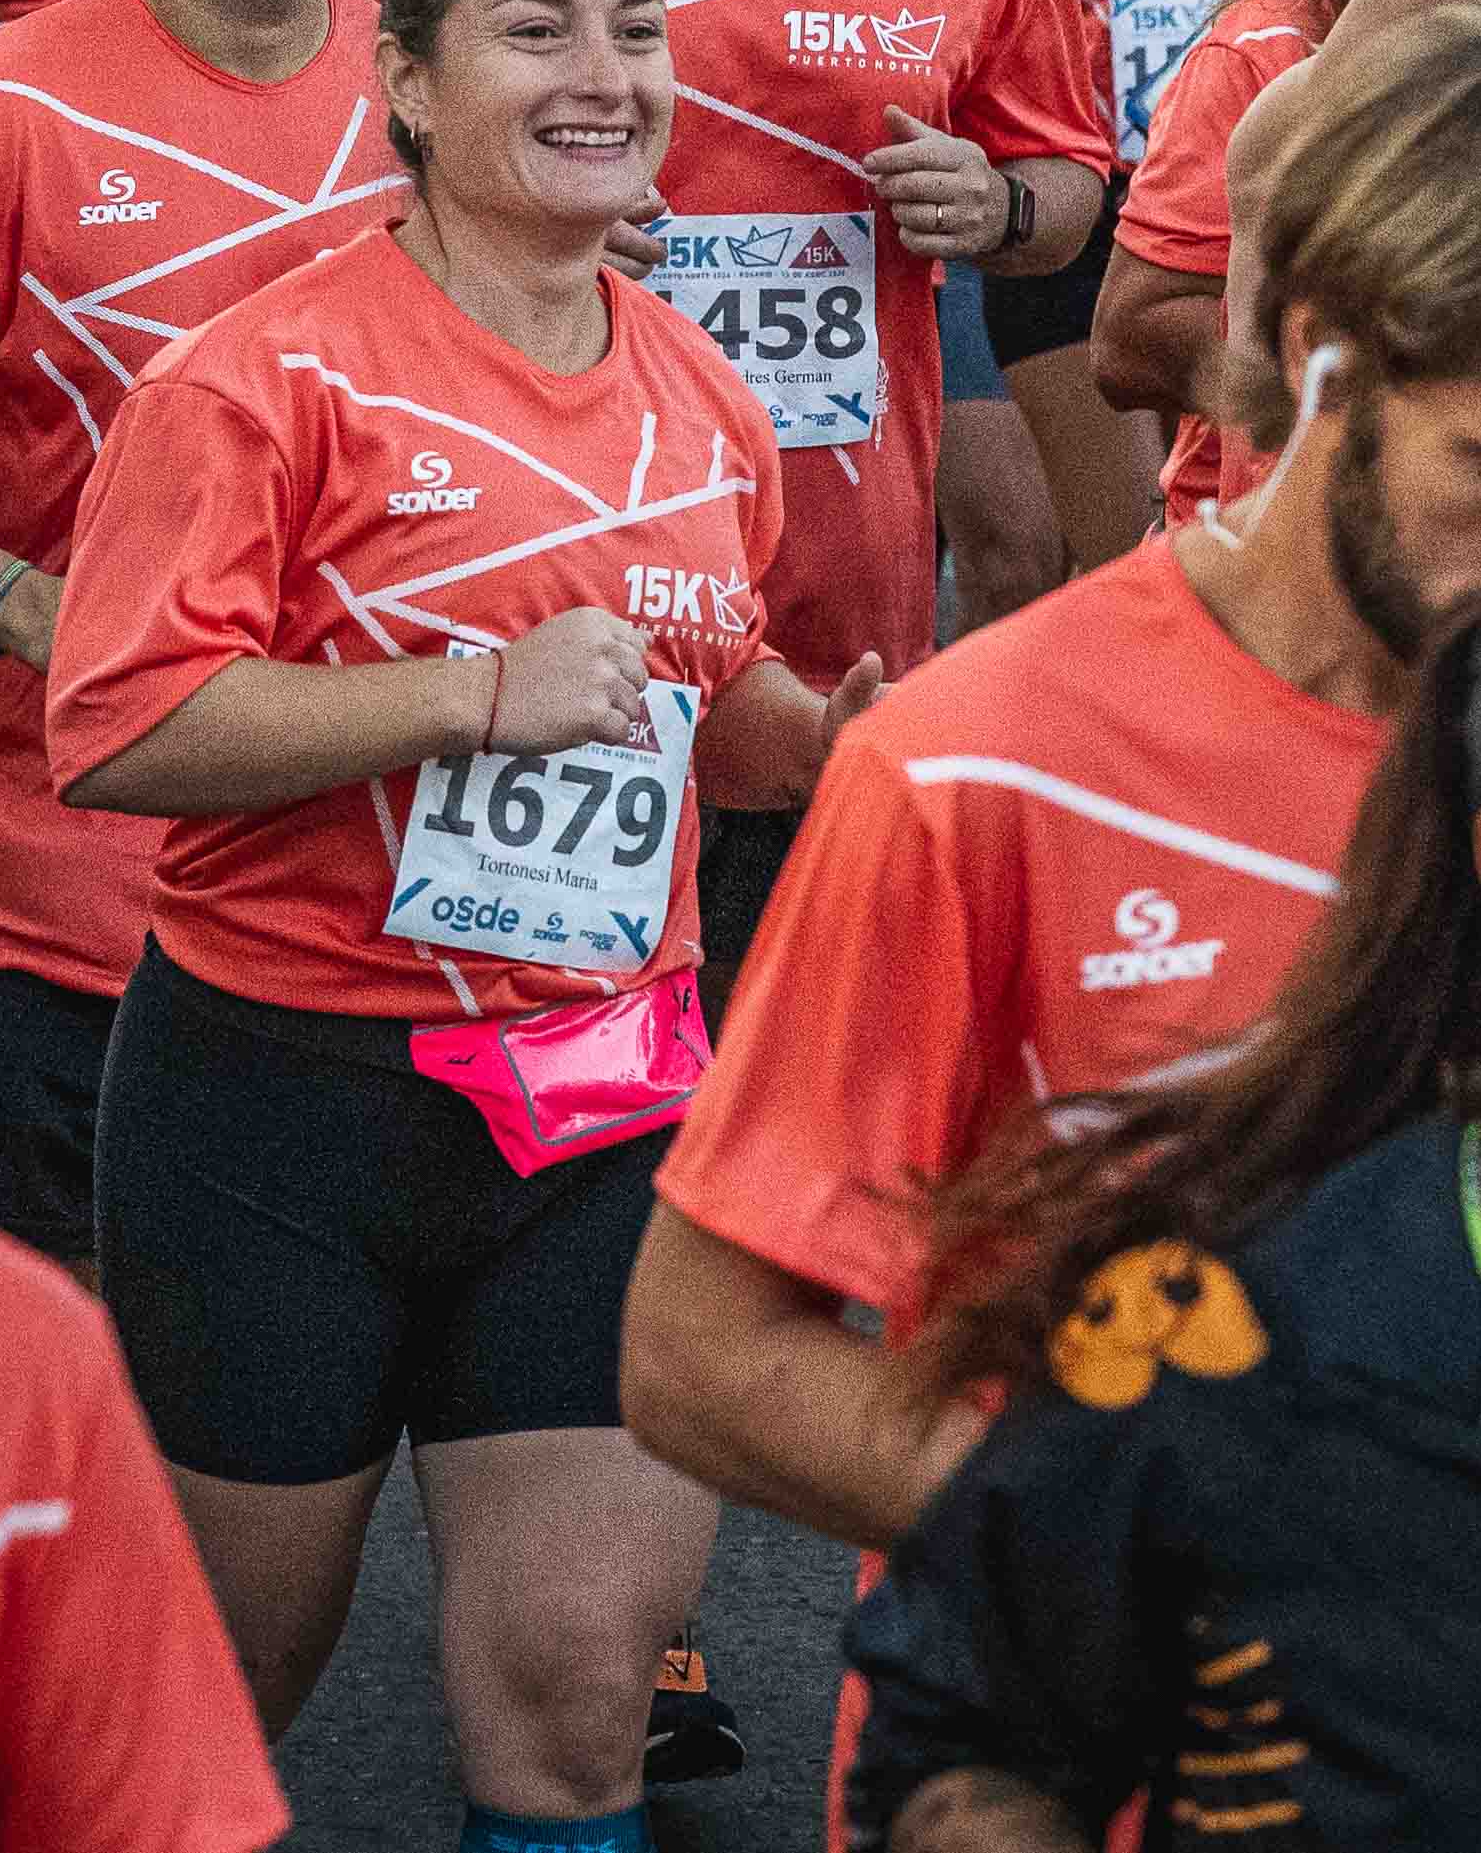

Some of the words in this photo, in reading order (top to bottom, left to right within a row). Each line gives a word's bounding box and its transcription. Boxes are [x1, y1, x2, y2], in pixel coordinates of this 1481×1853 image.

[783, 10, 868, 54] 15K
[788, 53, 866, 69] PUERTO
[874, 58, 933, 77] NORTE
[802, 245, 836, 265] 15K
[653, 285, 867, 361] 458
[774, 369, 833, 385] German
[625, 564, 706, 624] 15K
[627, 721, 653, 745] 5K
[424, 755, 668, 868] 1679
[475, 852, 550, 884] Tortonesi
[556, 866, 599, 892] Maria
[431, 895, 521, 934] osde
